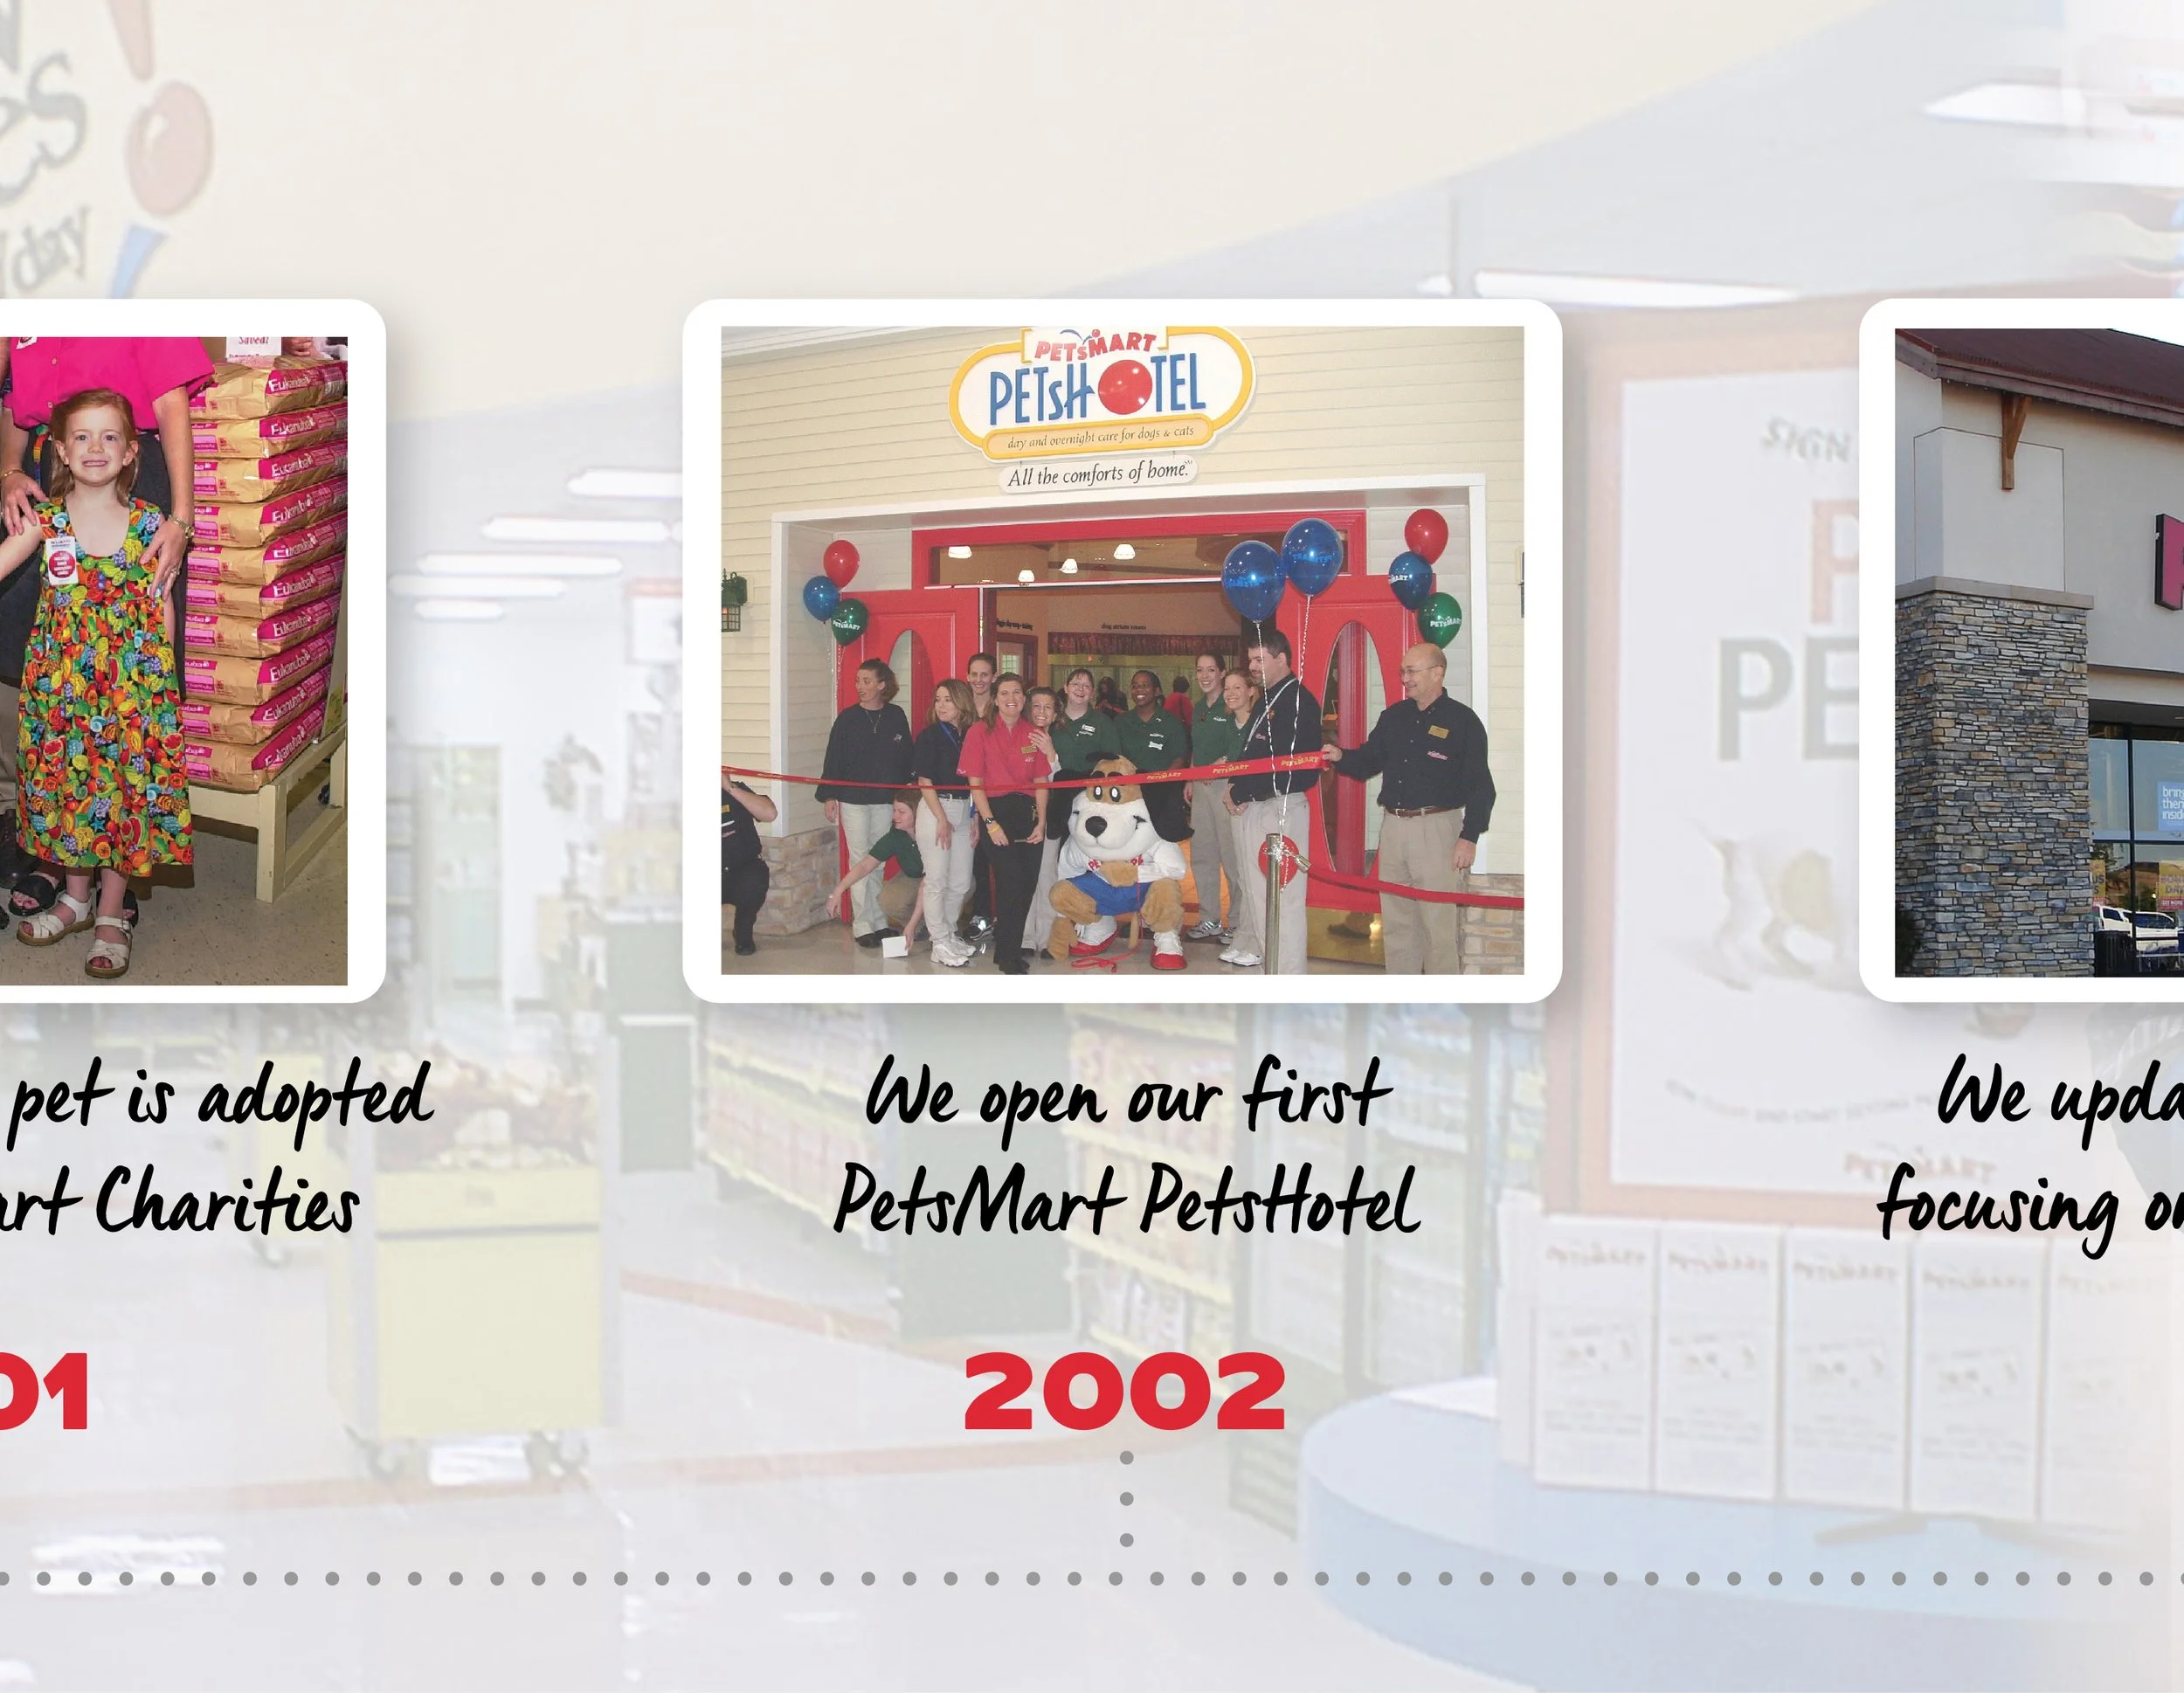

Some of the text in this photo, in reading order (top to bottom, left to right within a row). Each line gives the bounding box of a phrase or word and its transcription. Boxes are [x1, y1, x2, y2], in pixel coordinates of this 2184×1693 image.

[1008, 436, 1026, 451] day
[1029, 435, 1047, 447] and
[1049, 431, 1095, 446] overnight
[1098, 432, 1119, 442] care
[1119, 427, 1136, 443] for
[1137, 426, 1160, 441] dogs
[1174, 426, 1194, 437] cats
[1007, 466, 1033, 487] All
[1037, 466, 1059, 485] the
[1062, 462, 1123, 487] comforts
[1128, 460, 1145, 484] of
[1389, 574, 1408, 584] MART
[2162, 809, 2184, 819] insid
